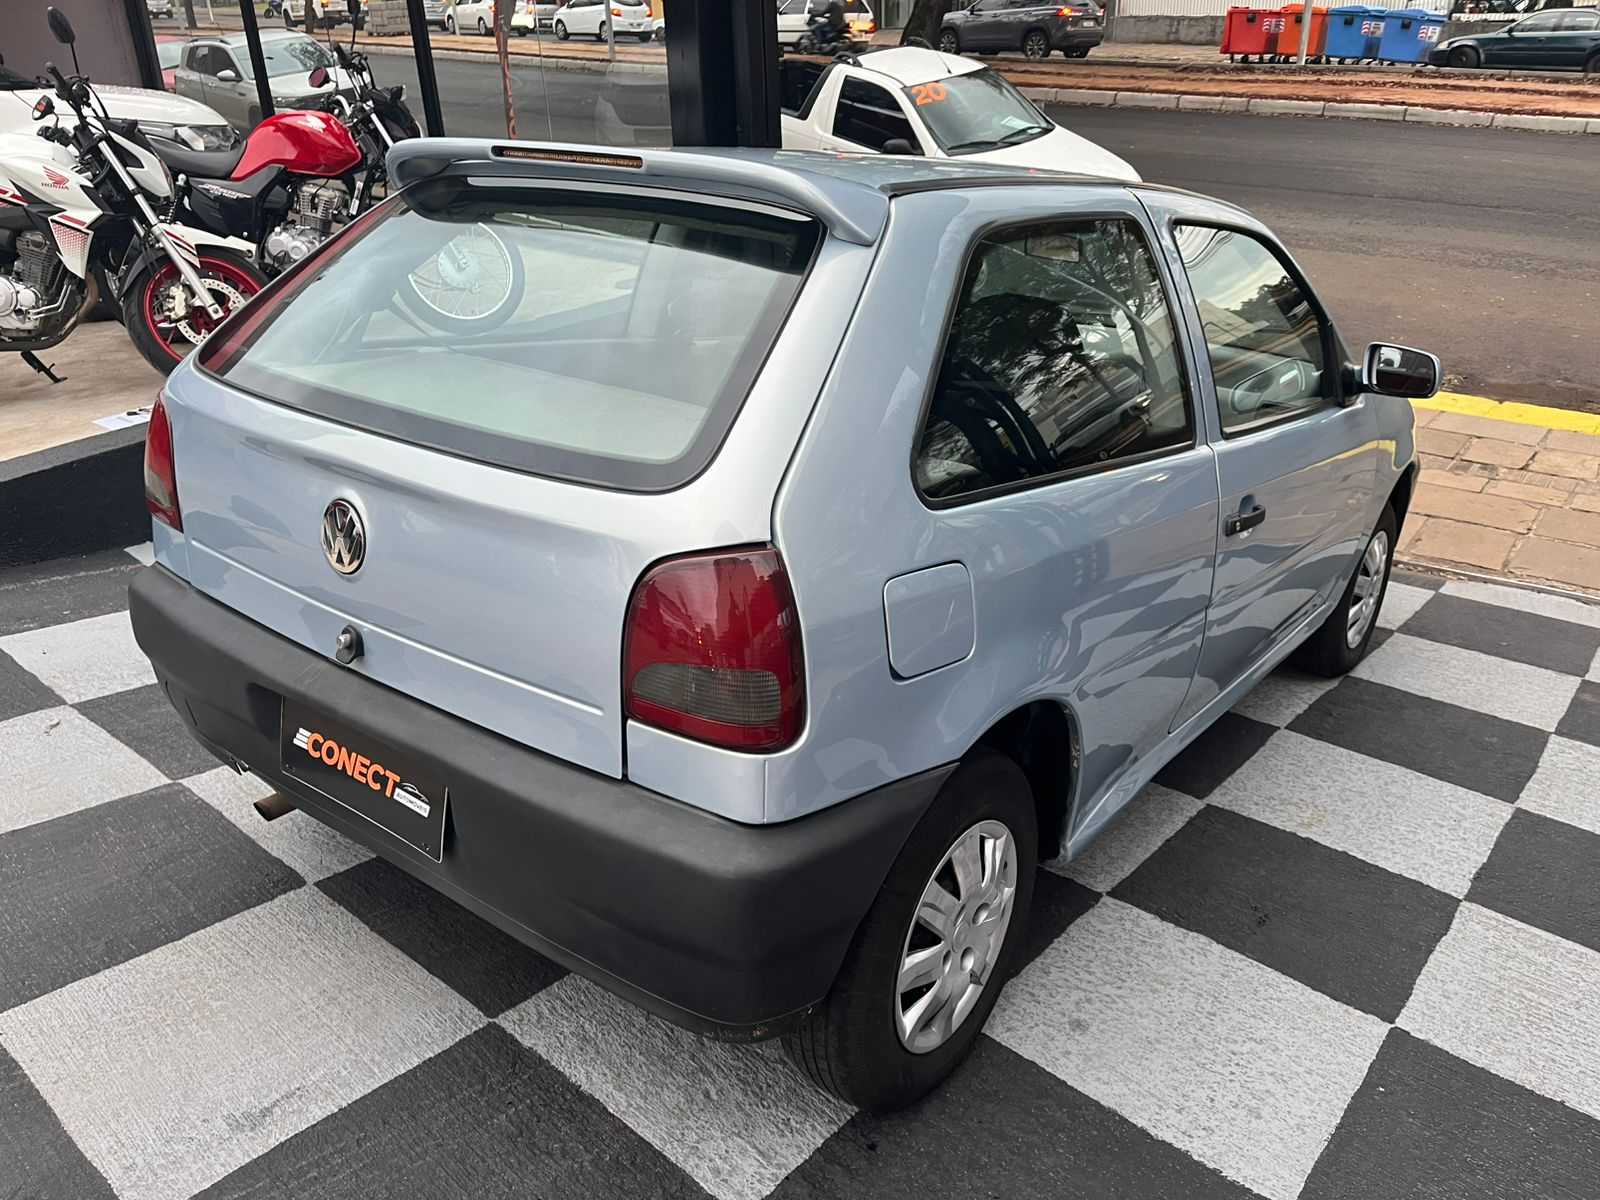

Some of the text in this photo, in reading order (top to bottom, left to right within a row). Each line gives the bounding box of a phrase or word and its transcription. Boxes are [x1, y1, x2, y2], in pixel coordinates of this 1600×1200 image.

[911, 82, 945, 106] 20
[41, 182, 70, 191] HONDA
[306, 732, 400, 798] CONECT
